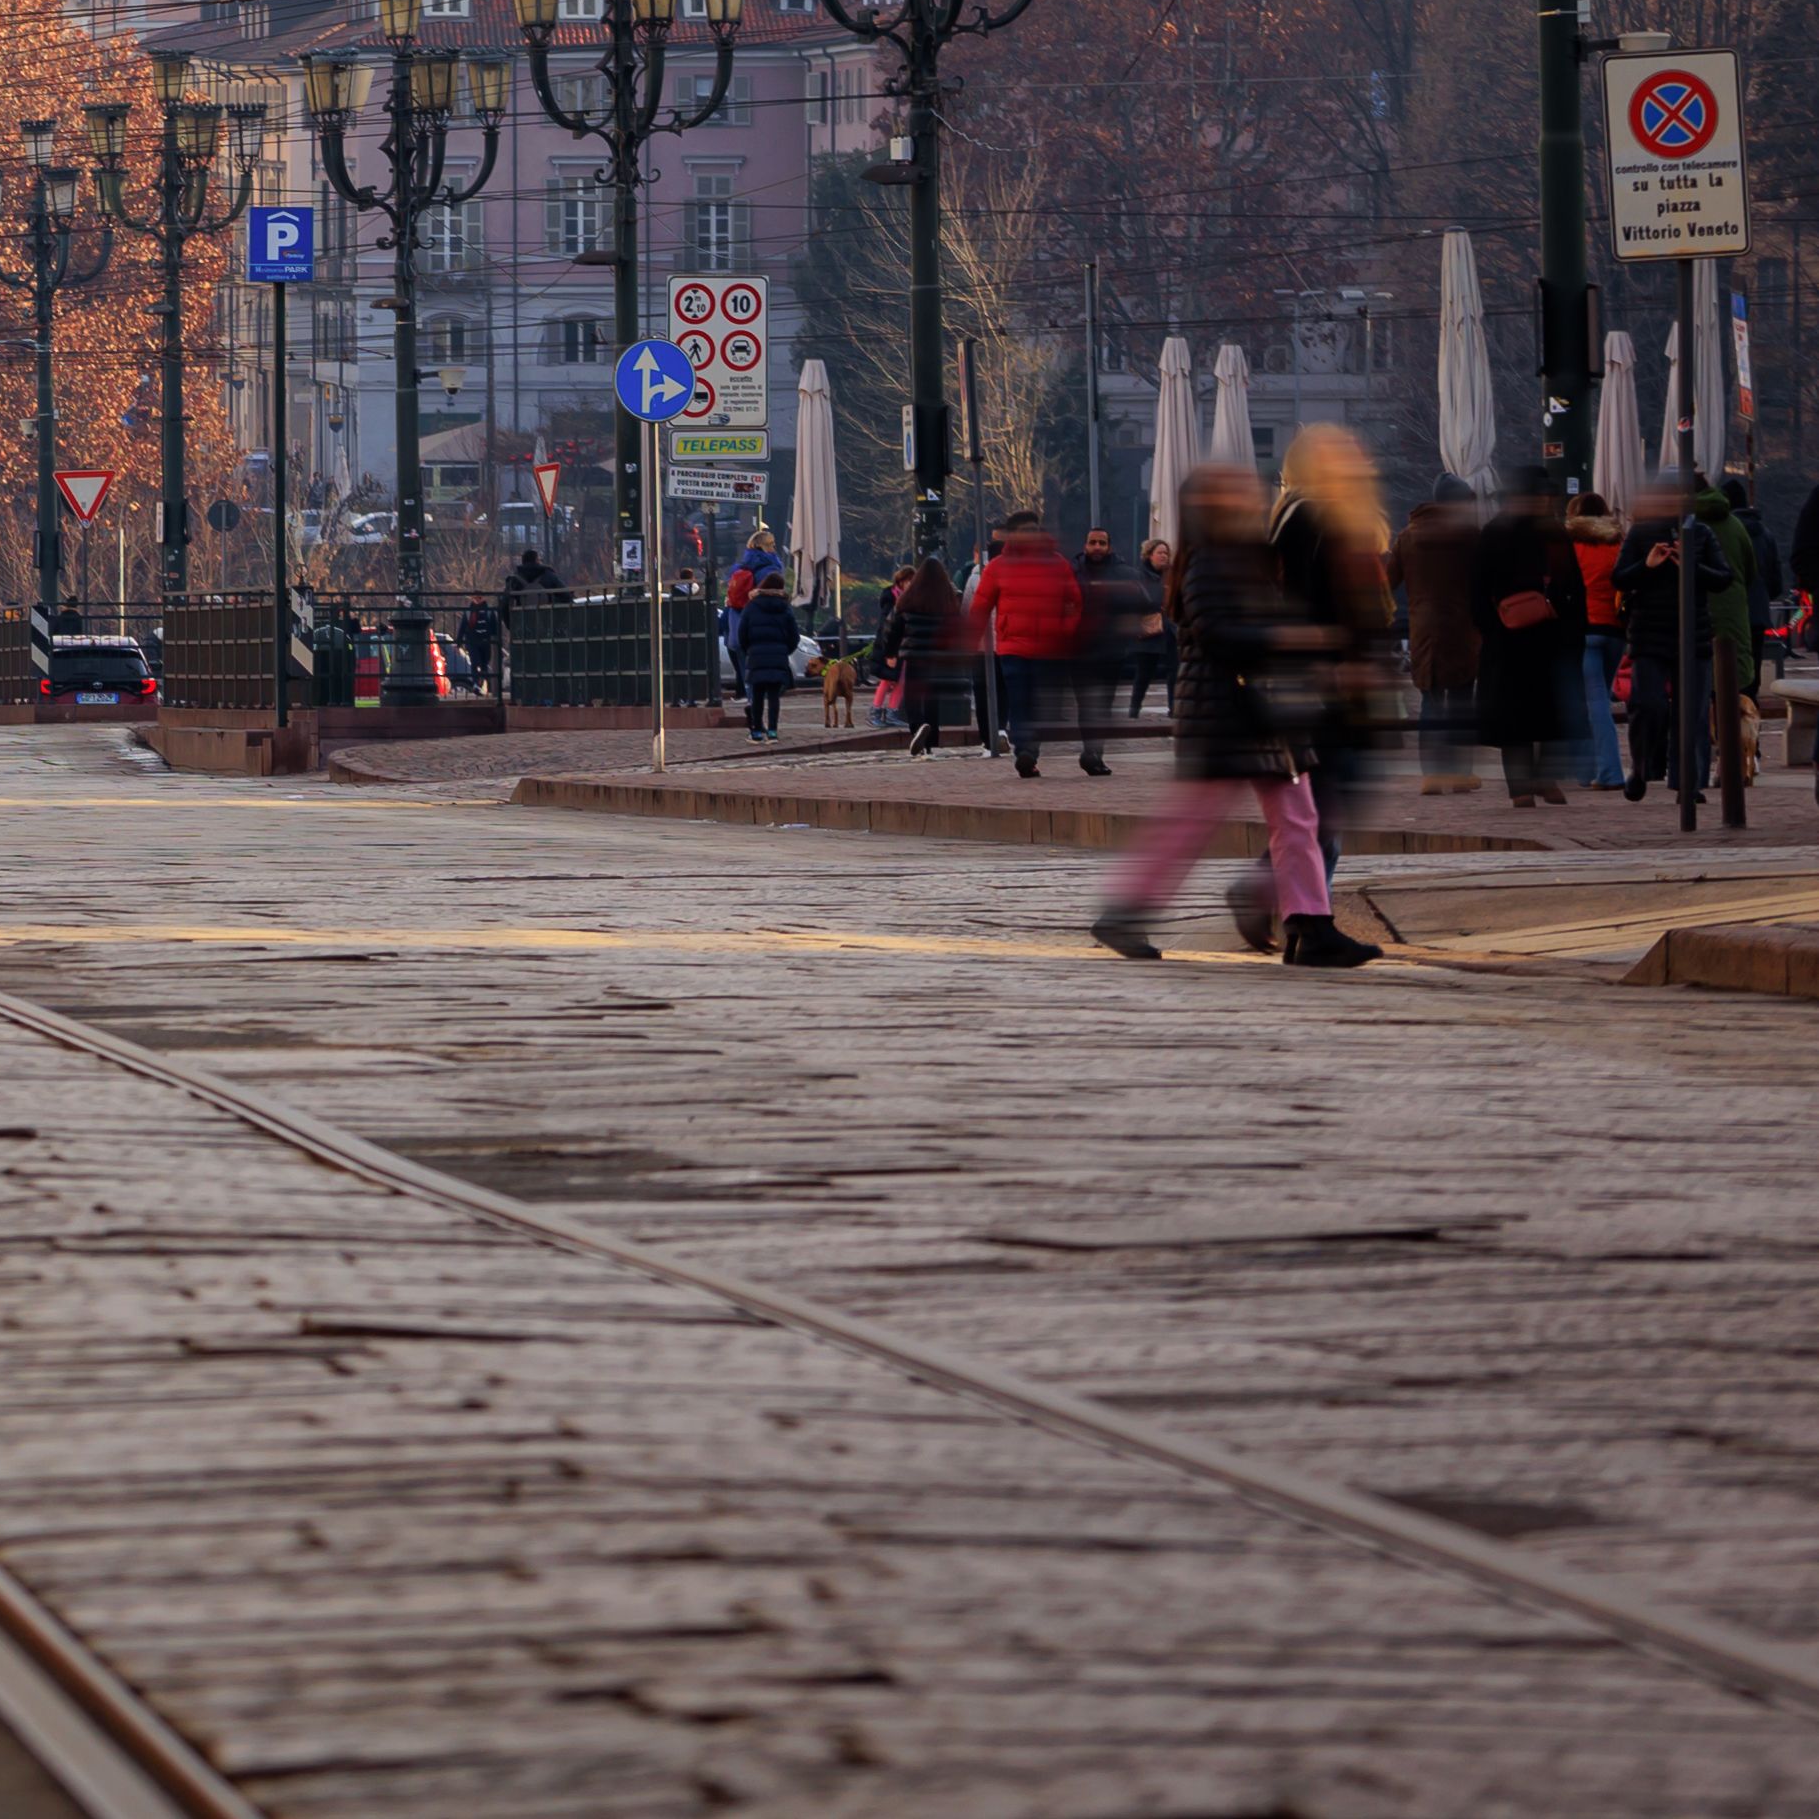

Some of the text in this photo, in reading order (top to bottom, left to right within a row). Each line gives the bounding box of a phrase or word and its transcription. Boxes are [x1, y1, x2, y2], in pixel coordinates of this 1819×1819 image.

[1615, 163, 1659, 174] controllo
[1661, 162, 1679, 172] con
[1632, 172, 1724, 192] su tutta la
[1657, 198, 1701, 218] piazza
[1622, 220, 1739, 241] Vittorio Veneto
[267, 222, 299, 261] P
[731, 295, 751, 313] 10
[682, 438, 757, 452] TELEPASS
